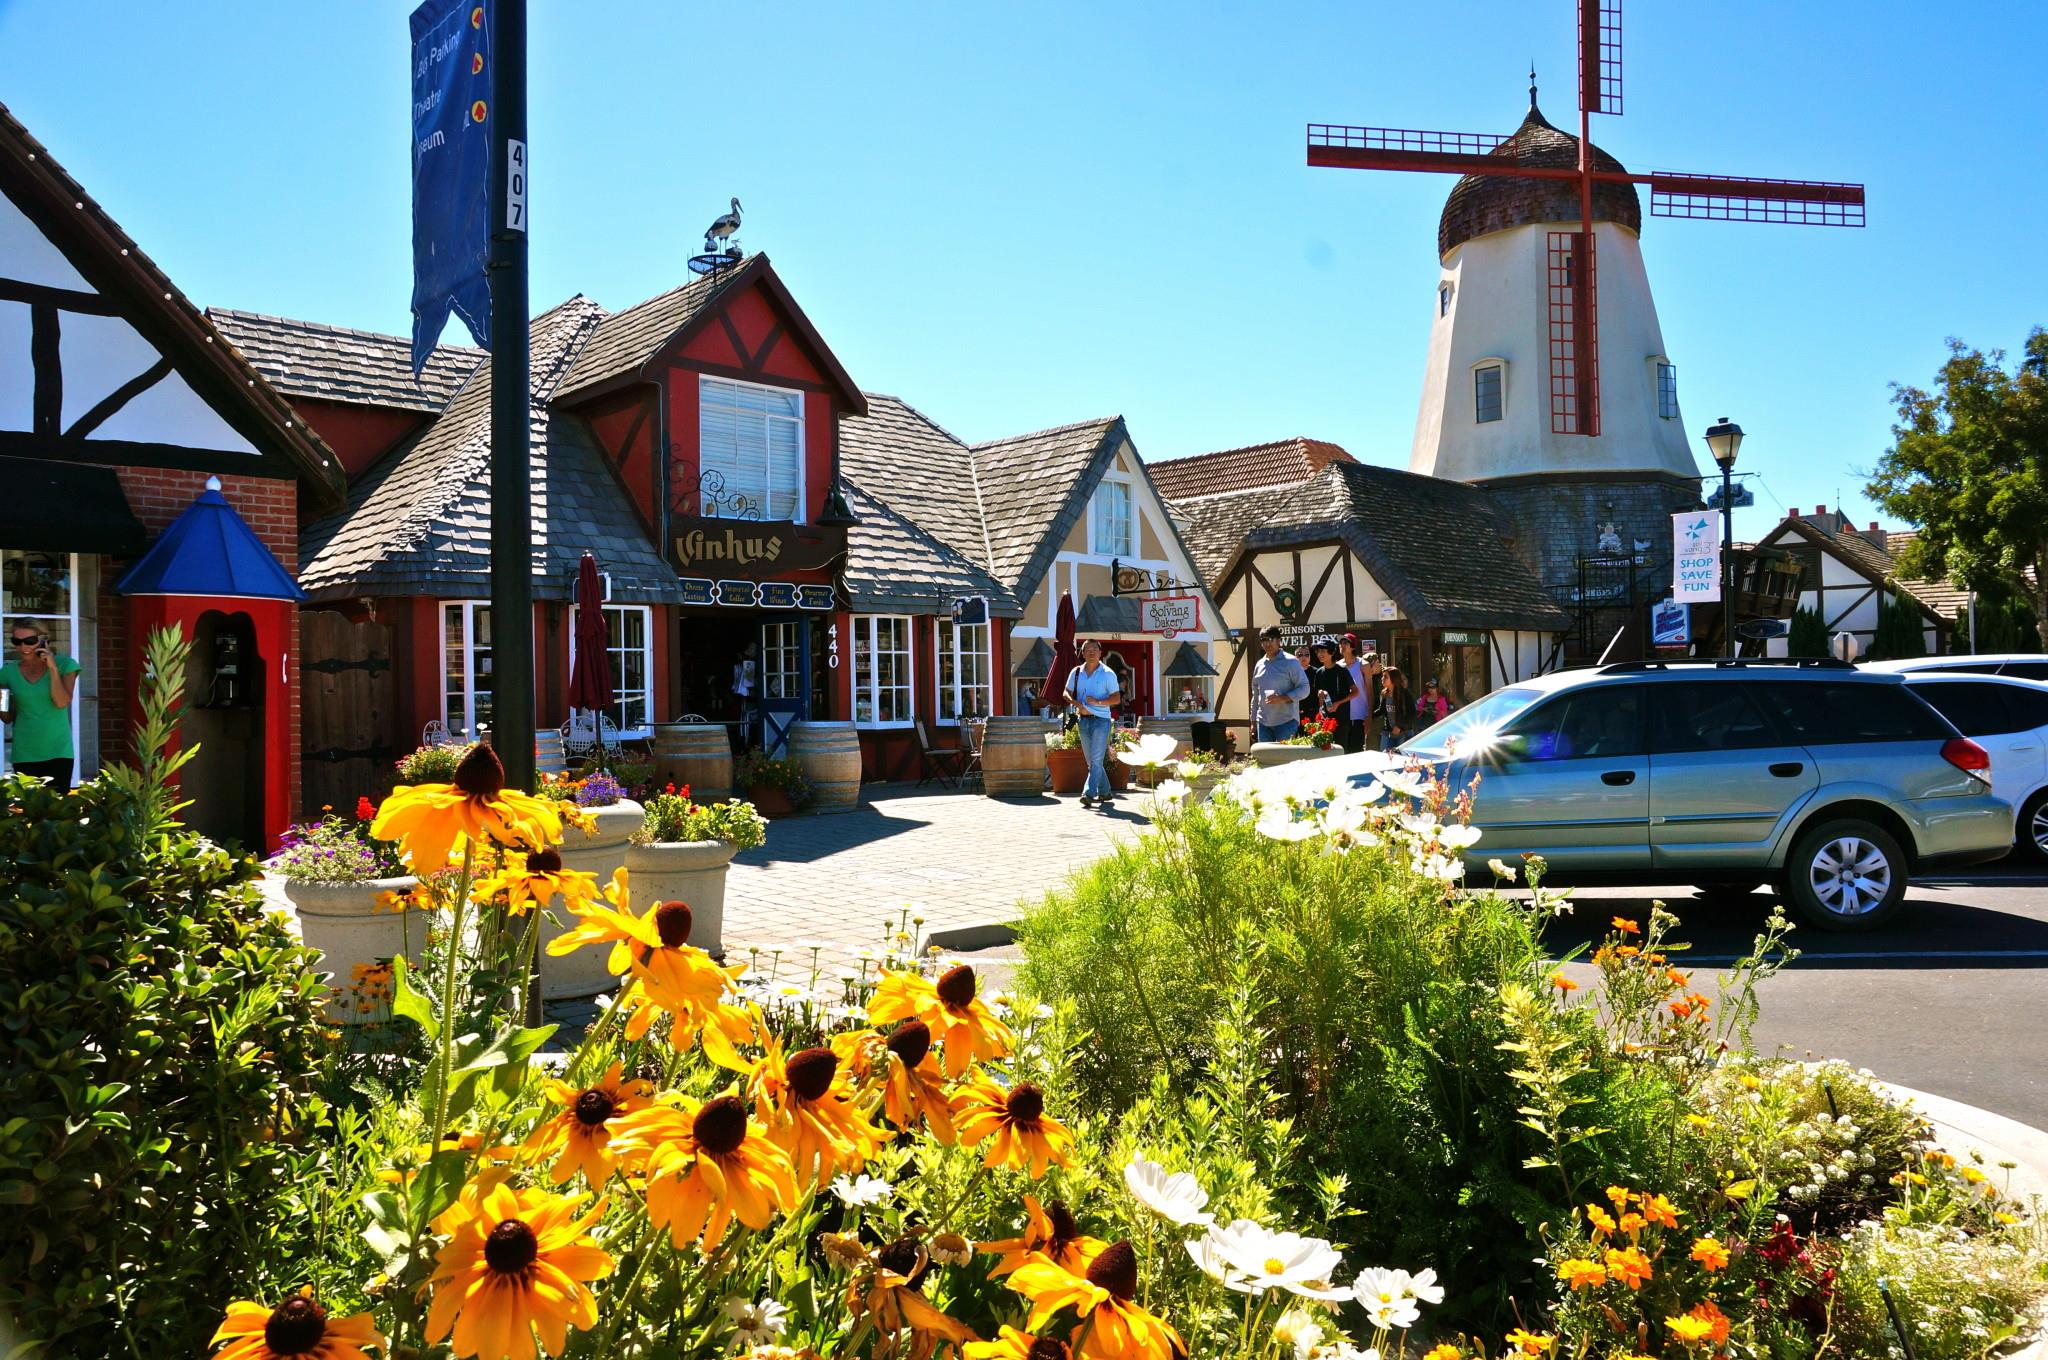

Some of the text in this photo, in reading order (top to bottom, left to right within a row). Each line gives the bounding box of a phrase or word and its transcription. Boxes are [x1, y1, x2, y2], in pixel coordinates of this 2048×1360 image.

[429, 30, 461, 66] Parking
[512, 144, 523, 226] 407
[675, 529, 783, 567] Vinhus
[1680, 557, 1713, 569] SHOP
[1680, 570, 1713, 580] SAVE
[1684, 582, 1710, 592] FUN
[1150, 604, 1190, 619] Solvang
[1155, 616, 1185, 630] Bakery
[1279, 624, 1325, 635] OHNSON'S
[828, 624, 839, 669] 440
[1280, 633, 1340, 647] WEL BOX
